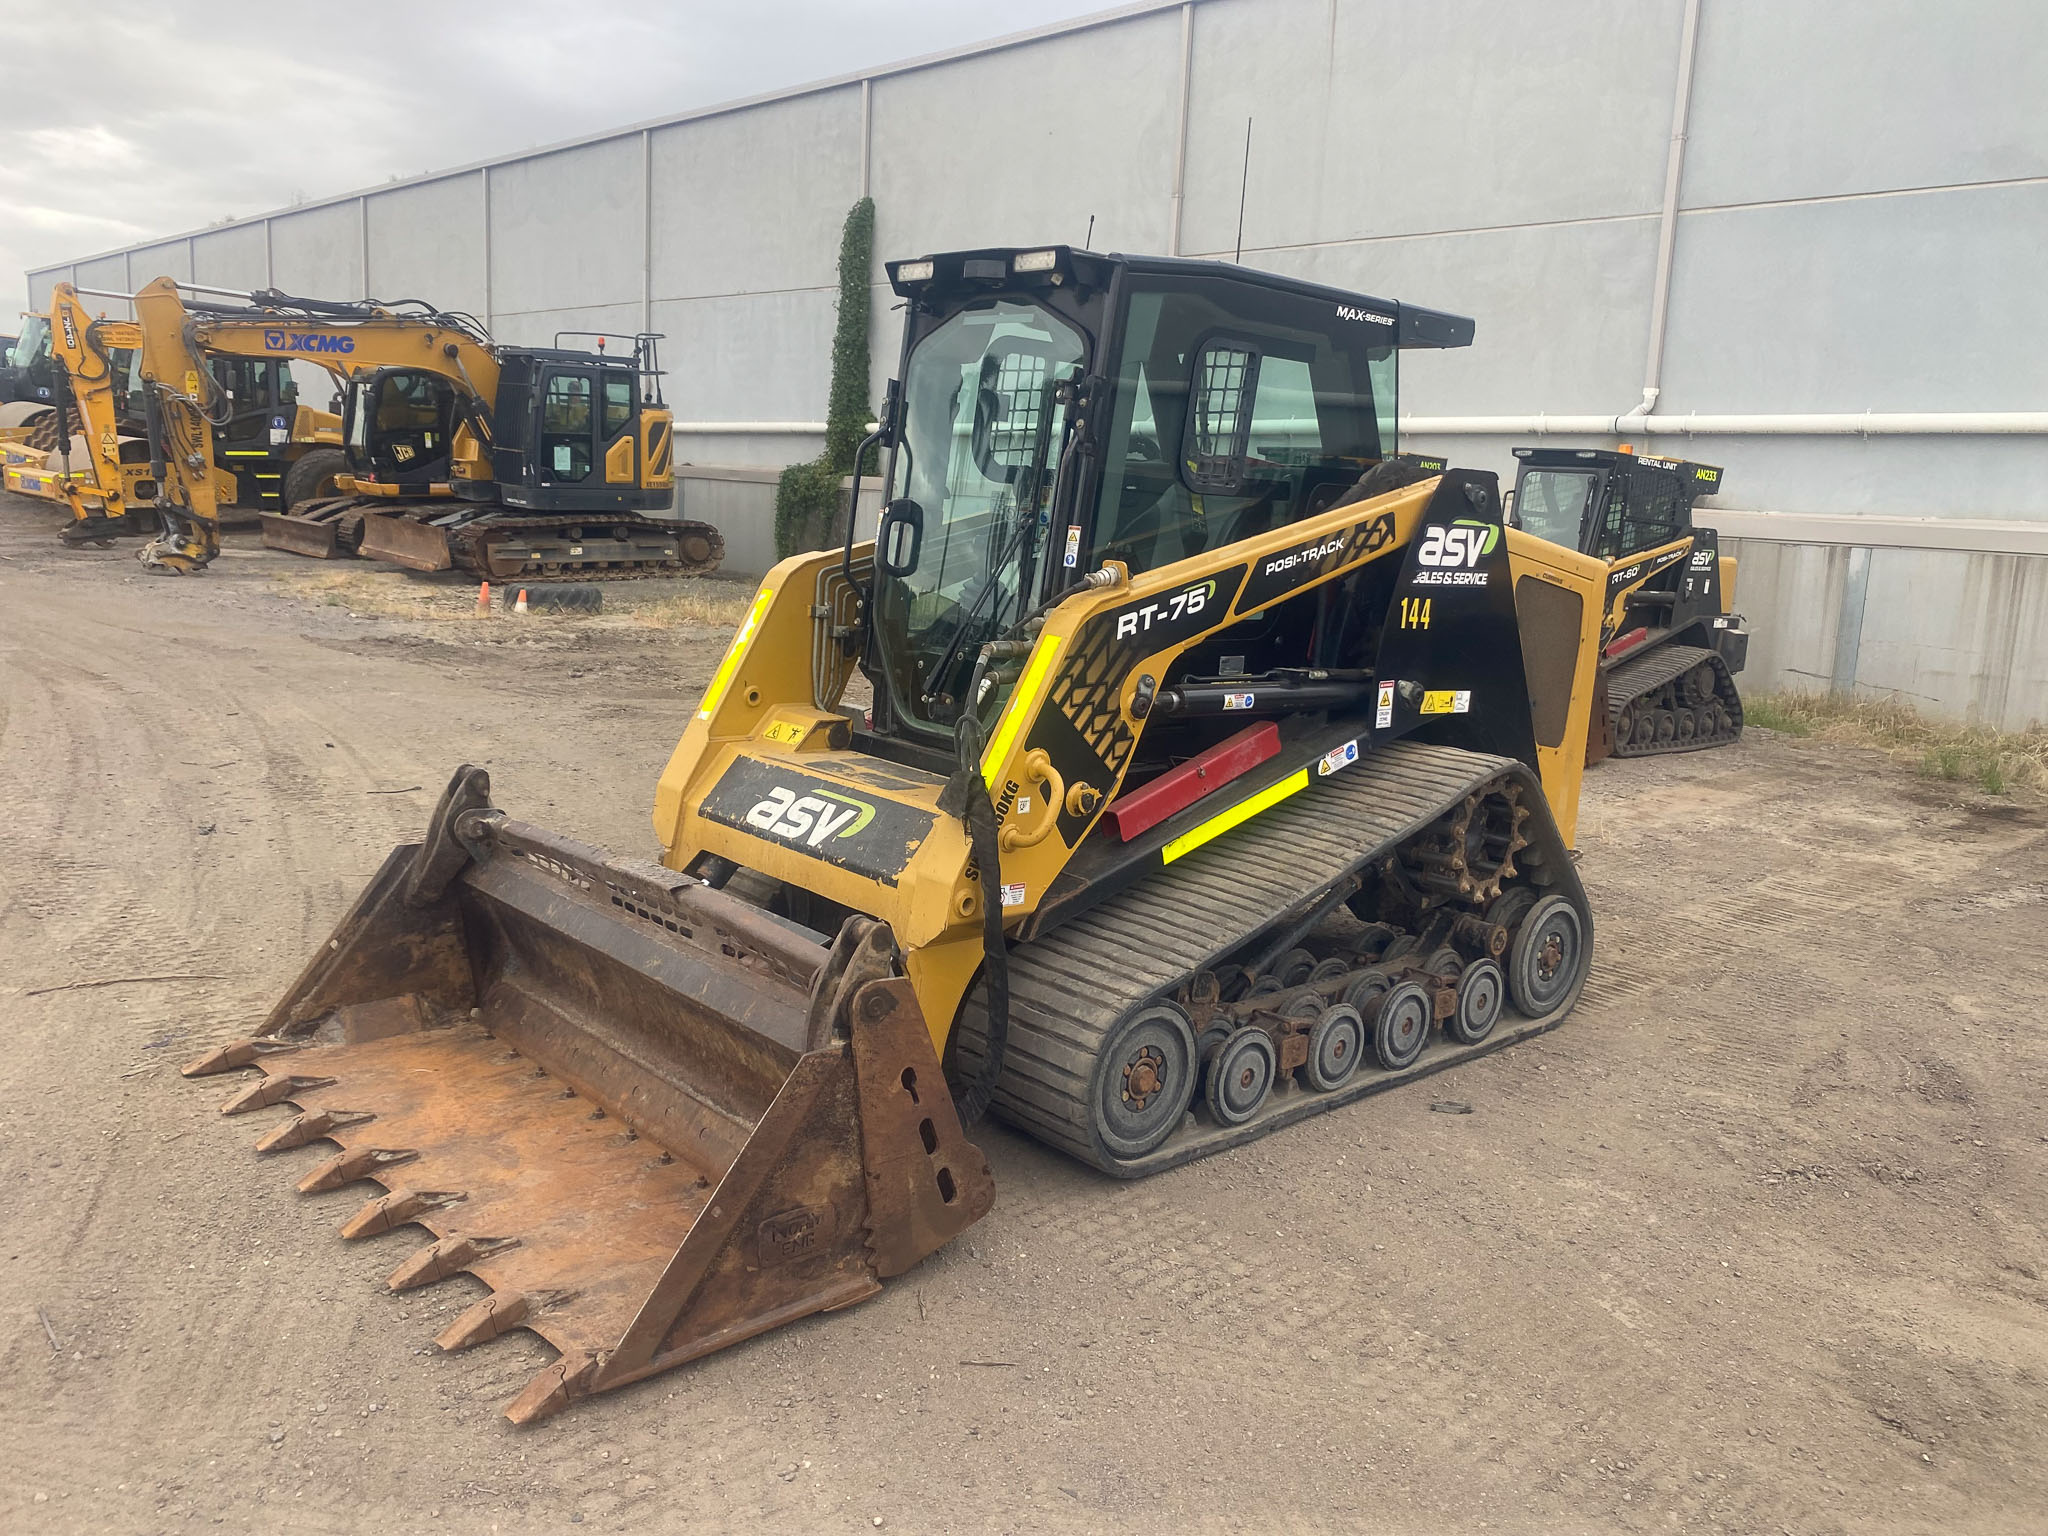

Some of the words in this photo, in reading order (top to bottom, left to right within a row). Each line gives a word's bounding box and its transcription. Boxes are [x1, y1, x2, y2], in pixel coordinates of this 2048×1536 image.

[288, 333, 355, 353] XCMG
[396, 446, 413, 460] JCB
[1638, 457, 1662, 468] RENTAL
[1662, 462, 1678, 471] UNIT
[1696, 468, 1718, 482] AN233
[1266, 537, 1345, 576] POSI-TRACK
[1442, 572, 1453, 585] &
[1452, 572, 1488, 586] SERVICE
[1611, 566, 1639, 585] RT-60
[1116, 587, 1207, 641] RT-75
[1400, 597, 1431, 630] 144
